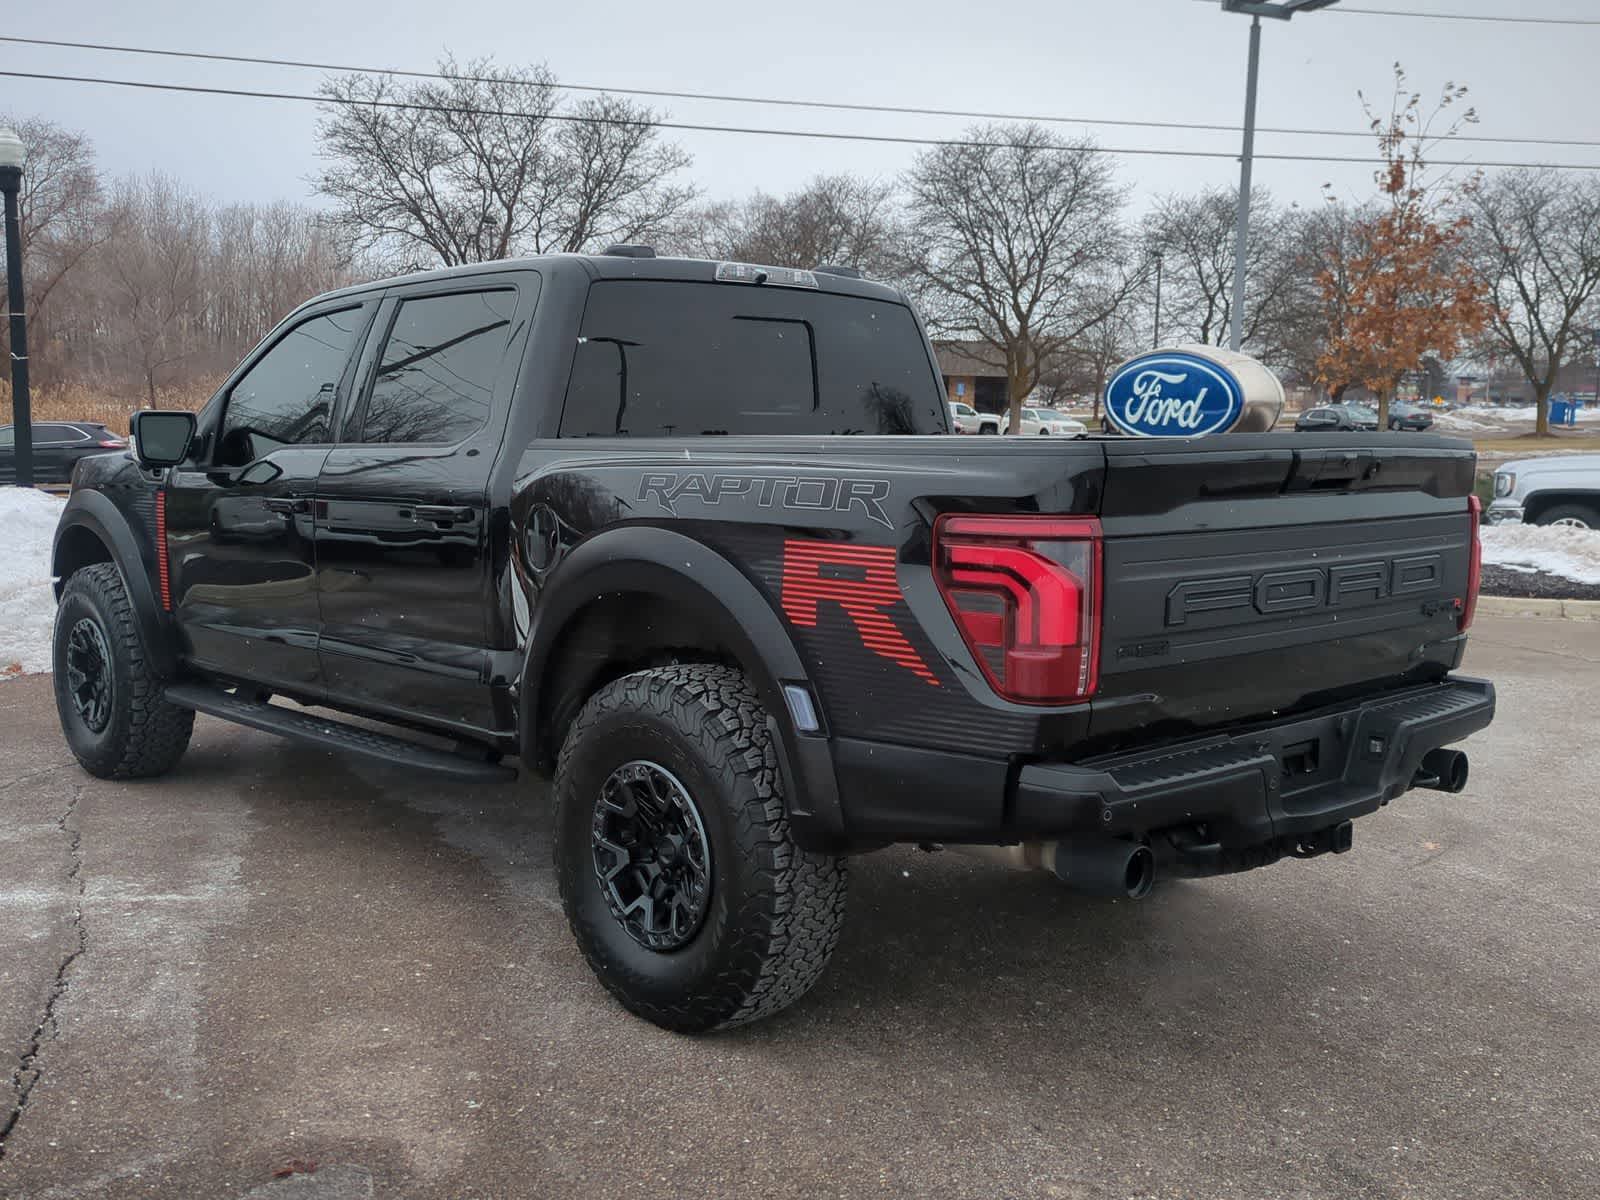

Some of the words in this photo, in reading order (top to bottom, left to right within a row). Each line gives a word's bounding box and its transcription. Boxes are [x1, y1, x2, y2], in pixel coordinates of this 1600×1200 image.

[1125, 370, 1208, 429] Ford
[637, 472, 895, 531] RAPTOR
[1164, 554, 1441, 627] FORD
